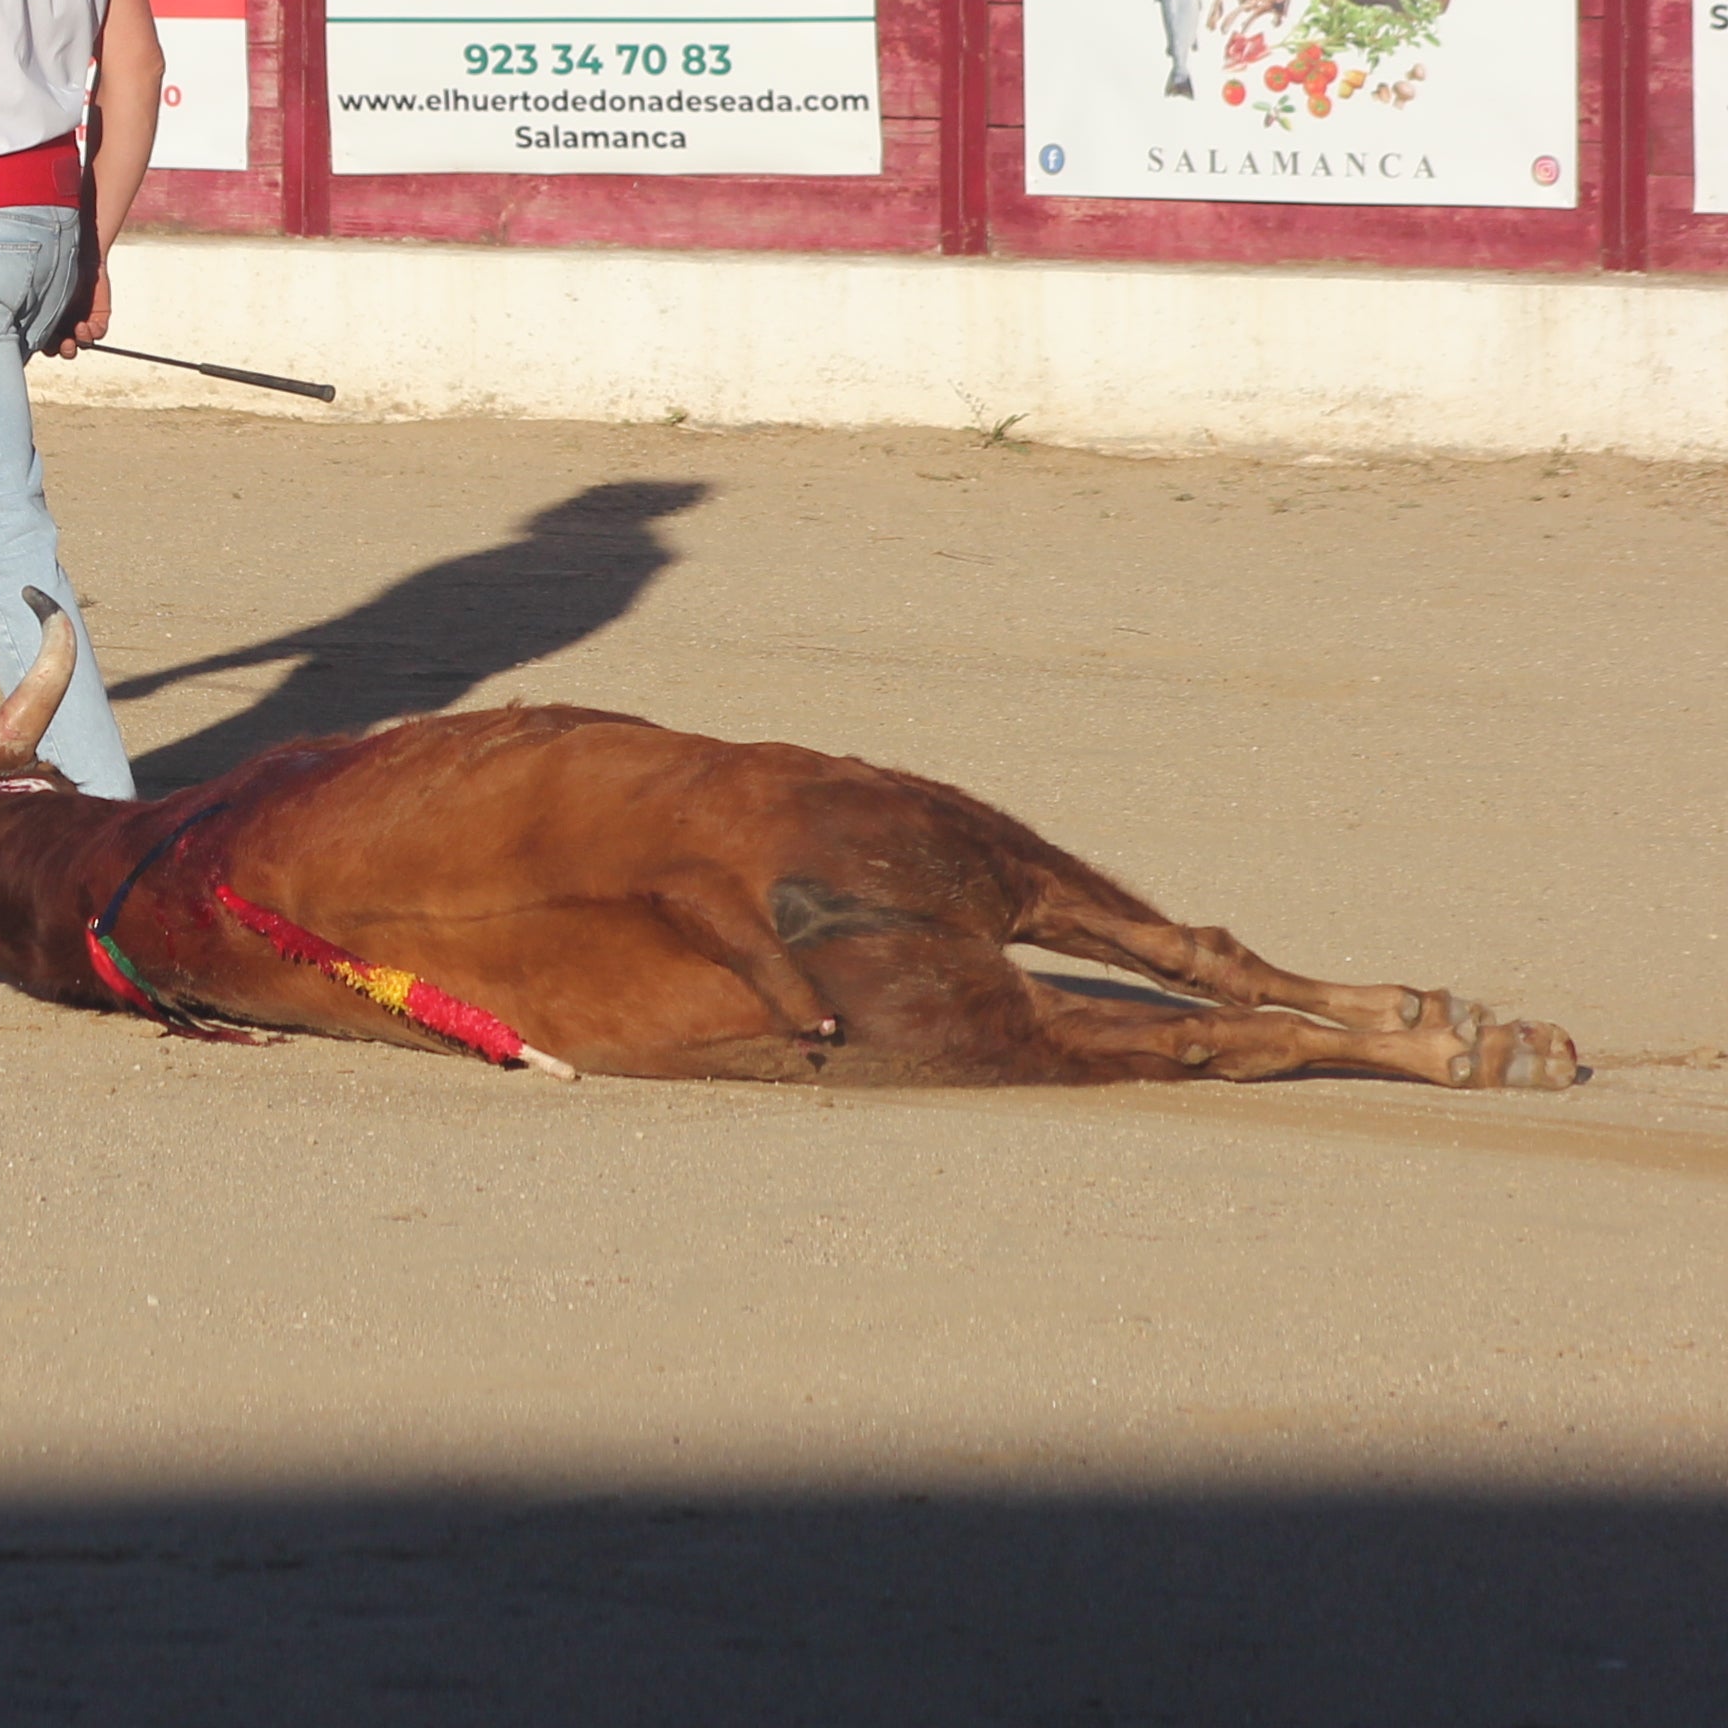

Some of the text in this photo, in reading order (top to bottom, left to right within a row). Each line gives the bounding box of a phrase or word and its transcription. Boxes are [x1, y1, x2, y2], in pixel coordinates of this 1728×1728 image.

[462, 43, 733, 76] 923 34 70 83
[338, 89, 870, 113] www.elhuertodedonadeseada.com
[514, 124, 687, 149] Salamanca
[1146, 146, 1437, 179] SALAMANCA
